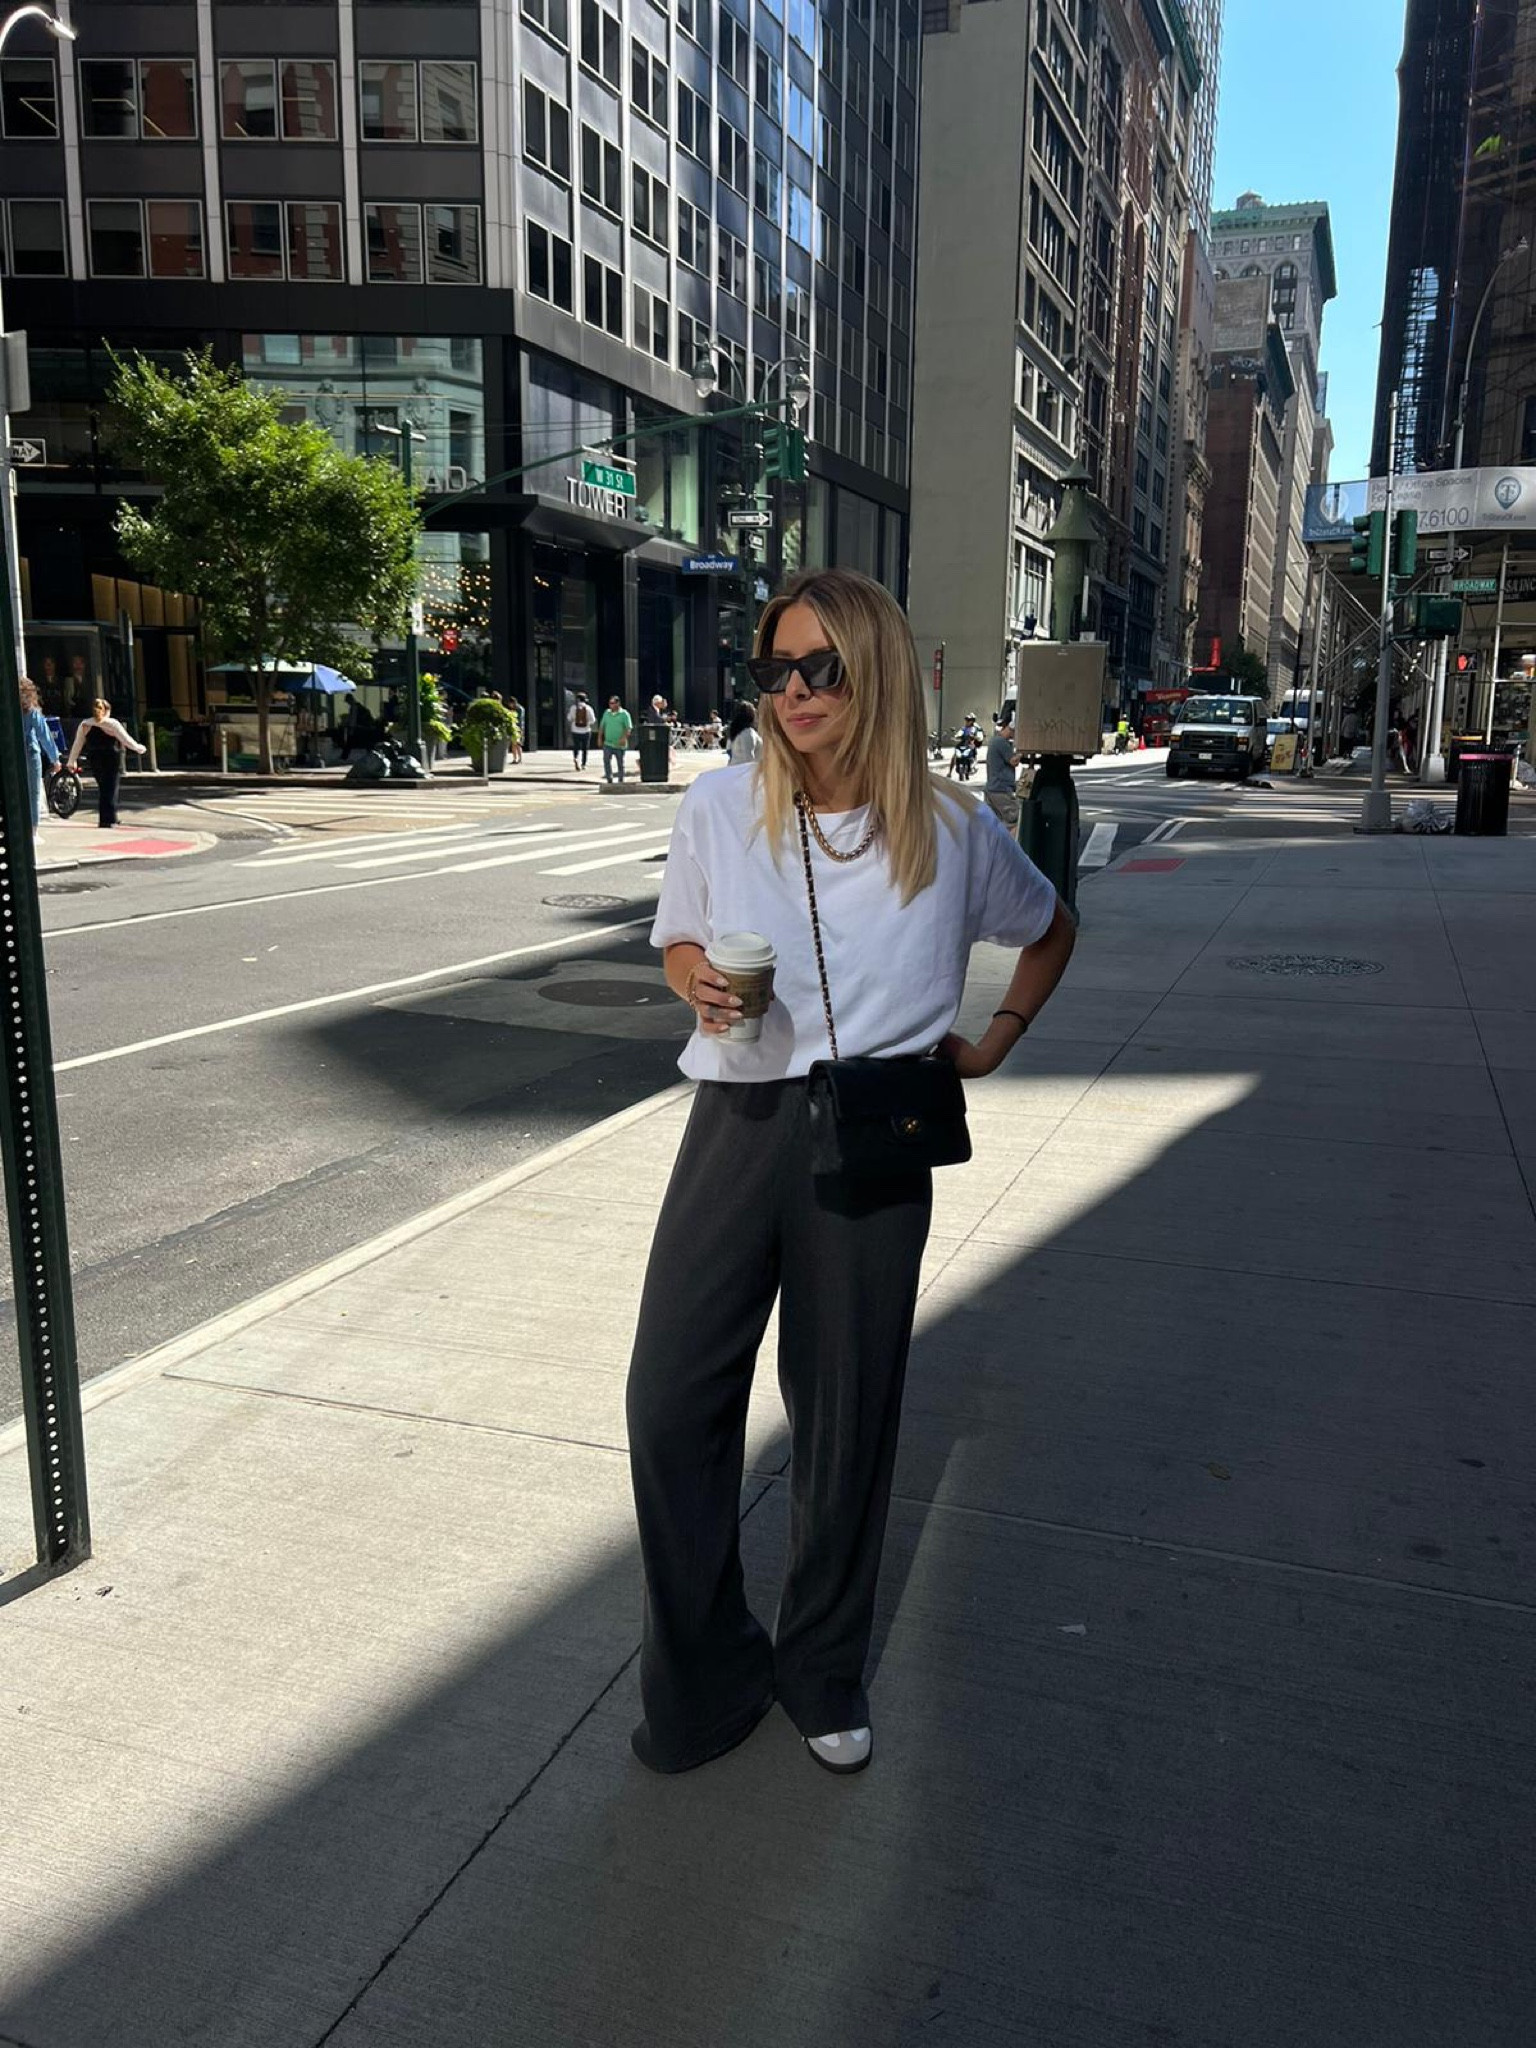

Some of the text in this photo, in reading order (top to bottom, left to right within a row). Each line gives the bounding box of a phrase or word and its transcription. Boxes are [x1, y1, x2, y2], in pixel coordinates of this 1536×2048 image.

[12, 447, 33, 457] WAY
[566, 476, 627, 520] TOWER
[690, 560, 734, 571] Broadway
[1454, 578, 1496, 591] BROADWAY
